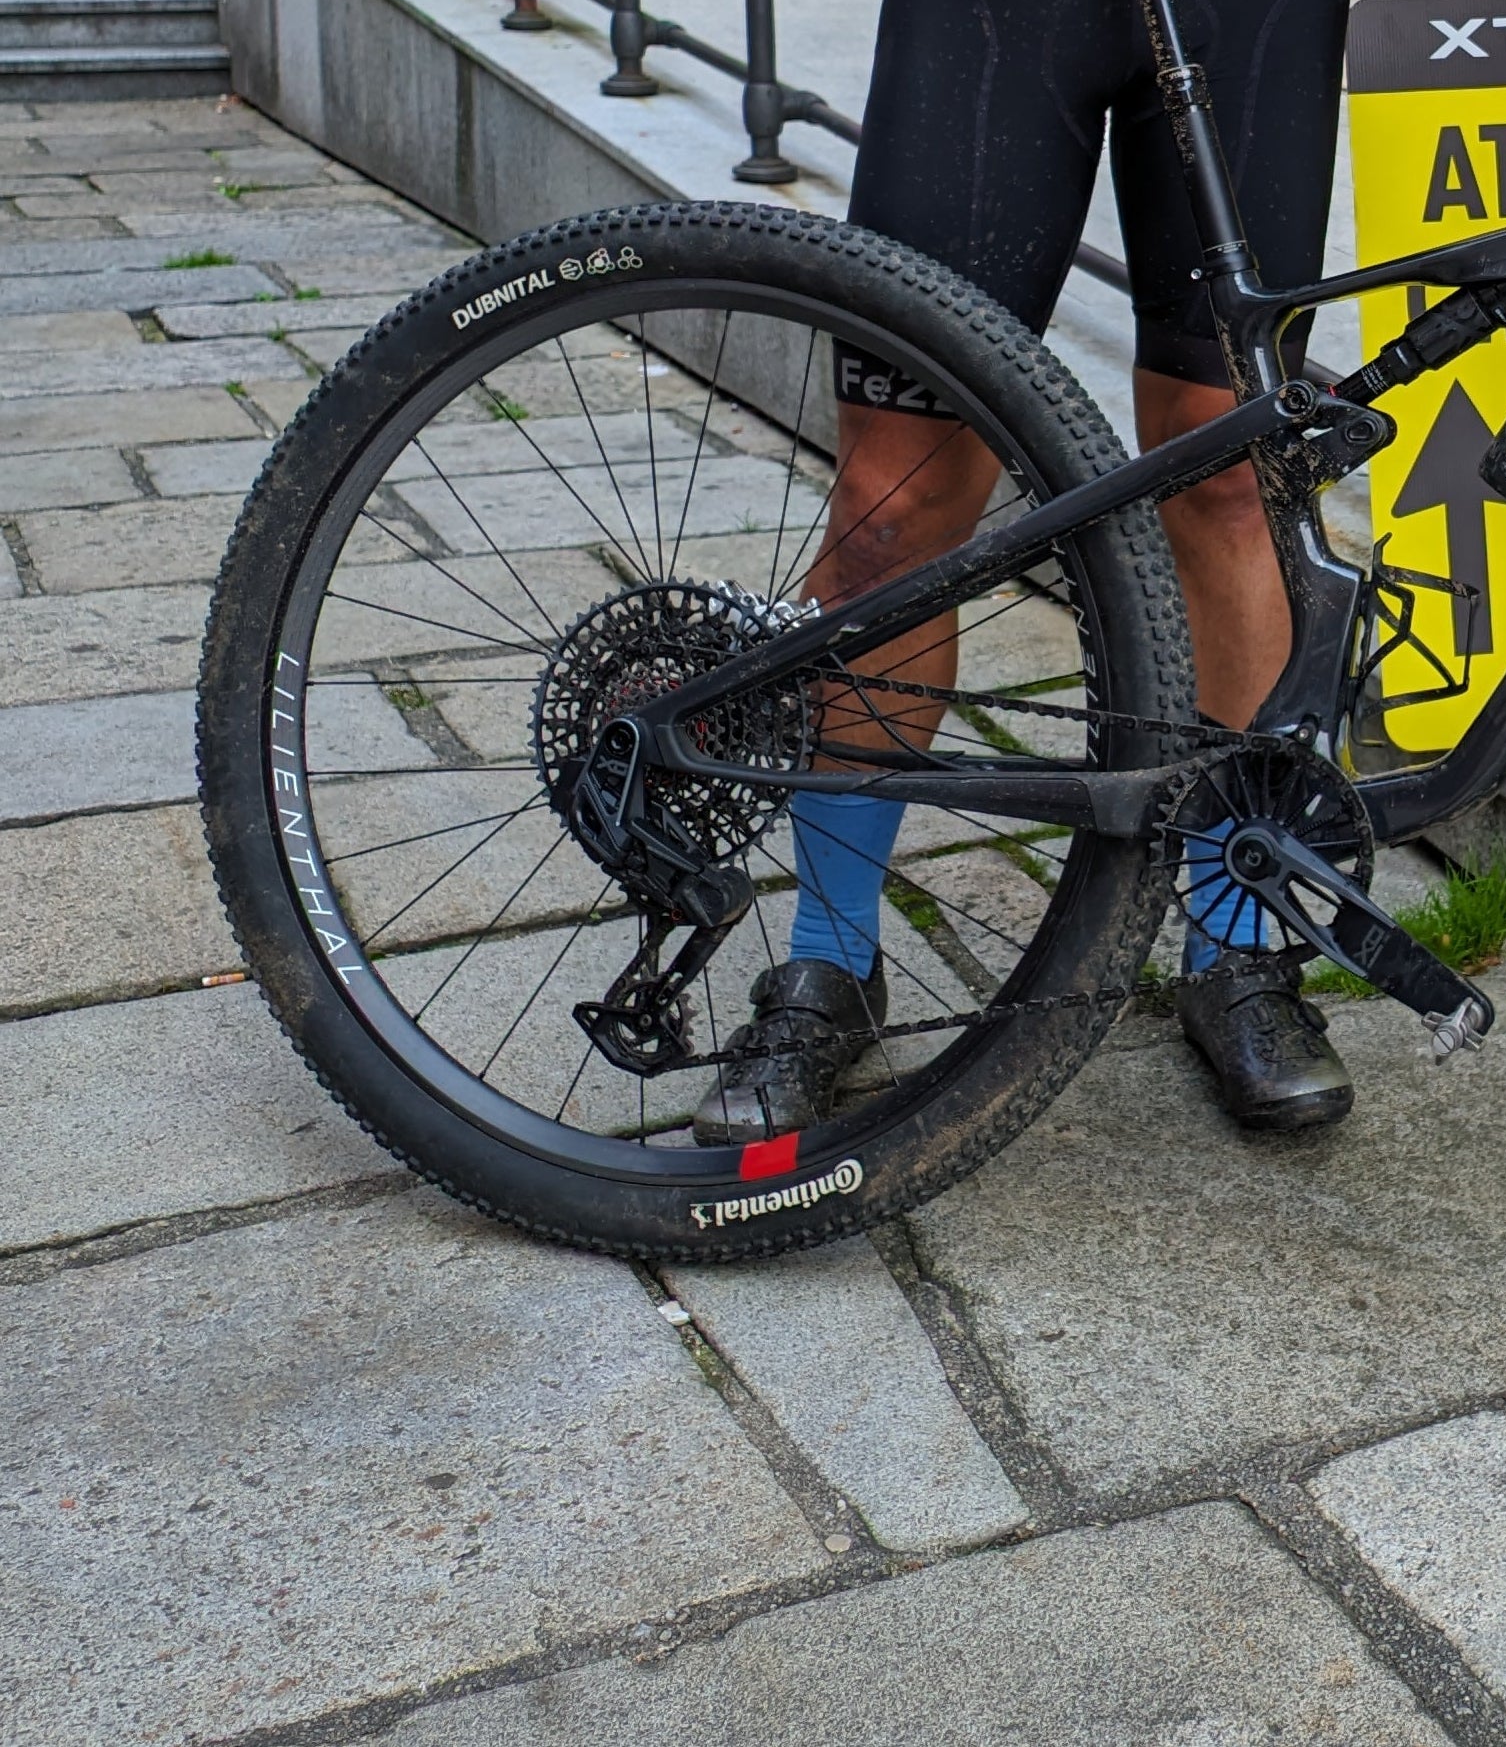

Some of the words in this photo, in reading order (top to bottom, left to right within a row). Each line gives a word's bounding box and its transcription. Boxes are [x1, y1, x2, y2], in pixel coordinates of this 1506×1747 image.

[451, 268, 556, 331] DUBNITAL
[841, 357, 952, 413] Fe2
[271, 650, 363, 986] LILIENTHAL
[715, 1158, 864, 1227] Continental
